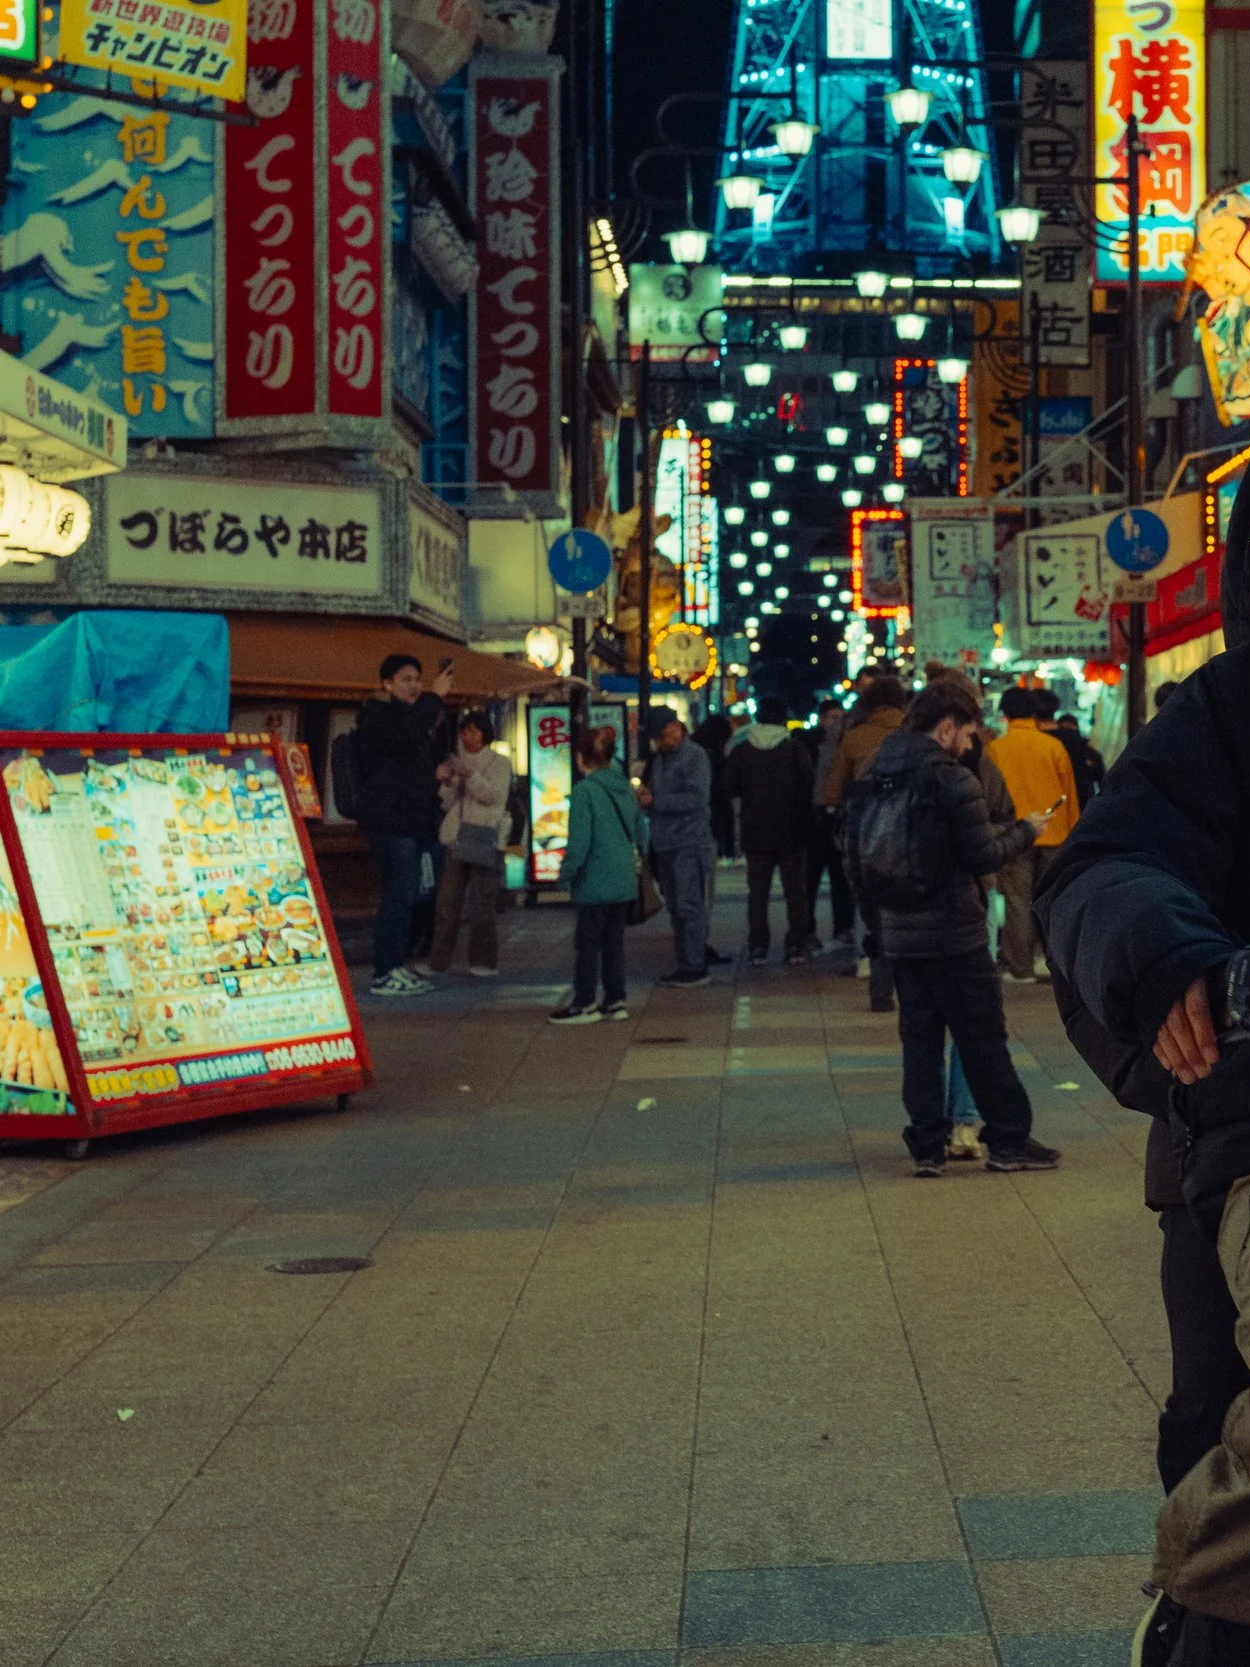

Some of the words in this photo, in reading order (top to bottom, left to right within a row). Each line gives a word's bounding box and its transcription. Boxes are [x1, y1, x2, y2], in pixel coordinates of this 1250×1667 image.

[86, 22, 230, 81] チャンピオン
[1107, 38, 1194, 217] 横綱
[119, 506, 368, 564] づぼらや本店
[537, 716, 572, 749] 串
